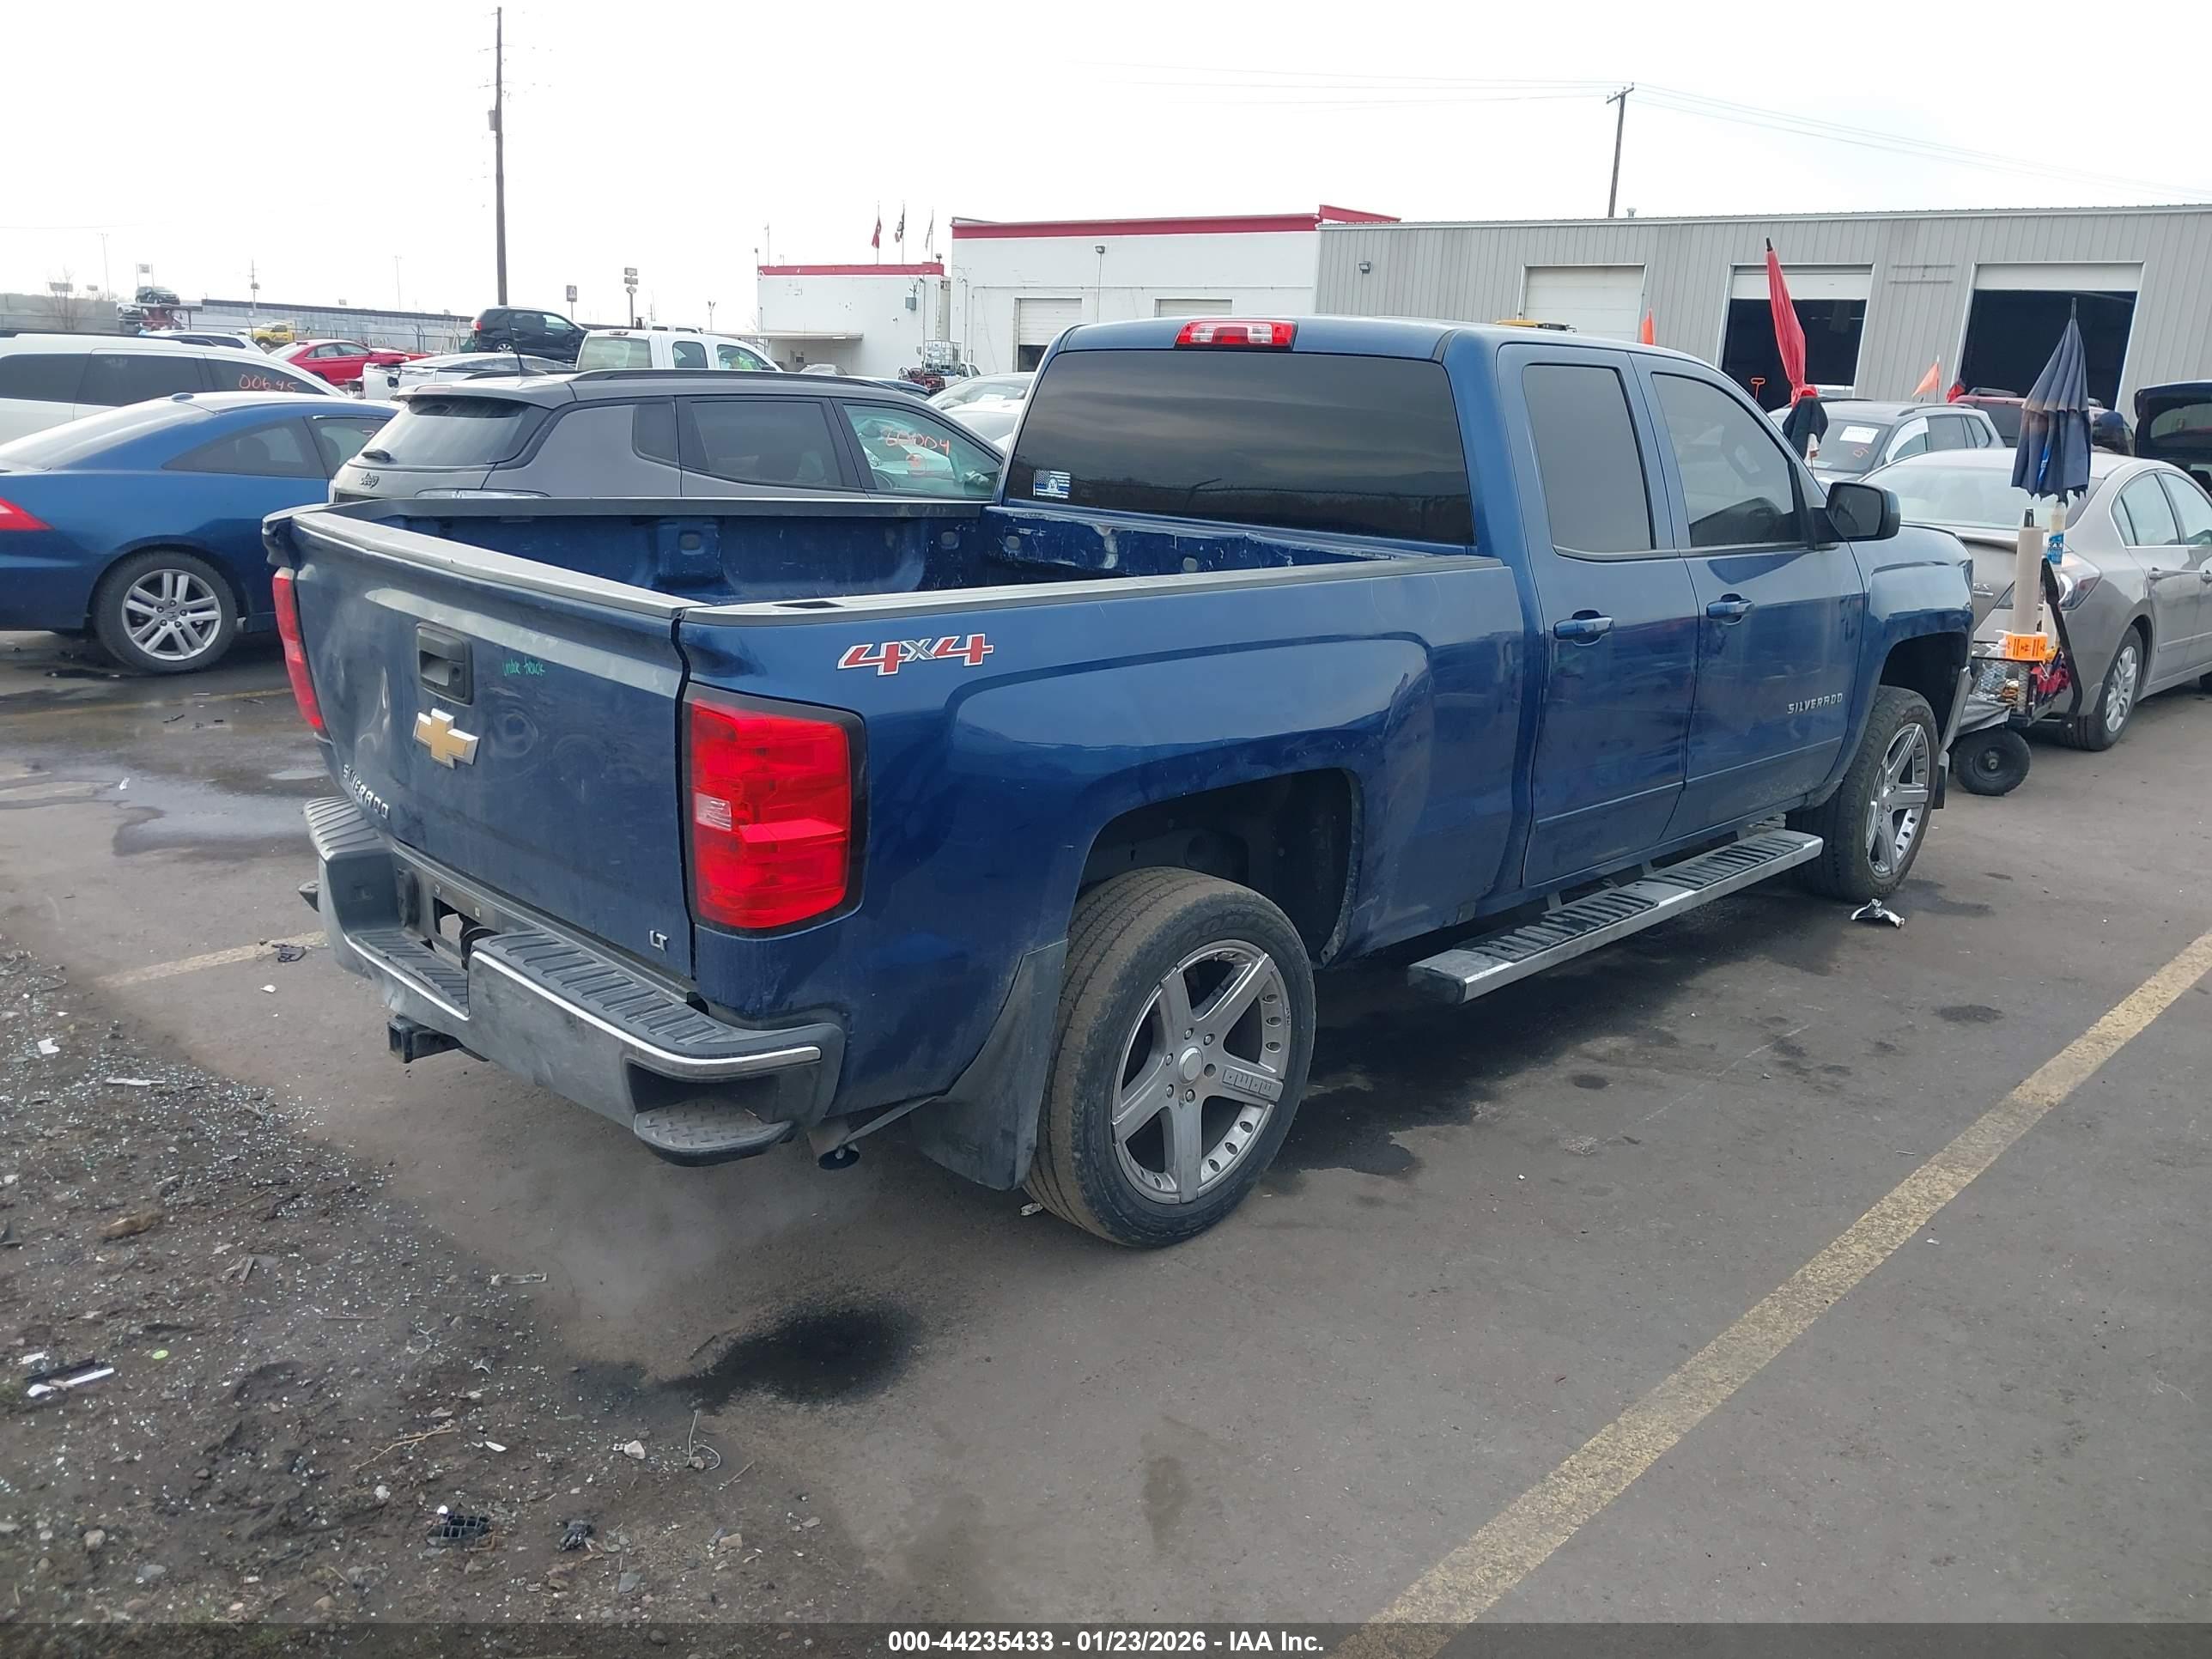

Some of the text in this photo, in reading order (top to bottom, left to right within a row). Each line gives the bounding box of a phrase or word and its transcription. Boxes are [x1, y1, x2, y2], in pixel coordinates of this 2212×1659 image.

[1787, 692, 1843, 714] SILVERADO
[343, 763, 390, 819] SILVERADO
[649, 930, 668, 951] LT
